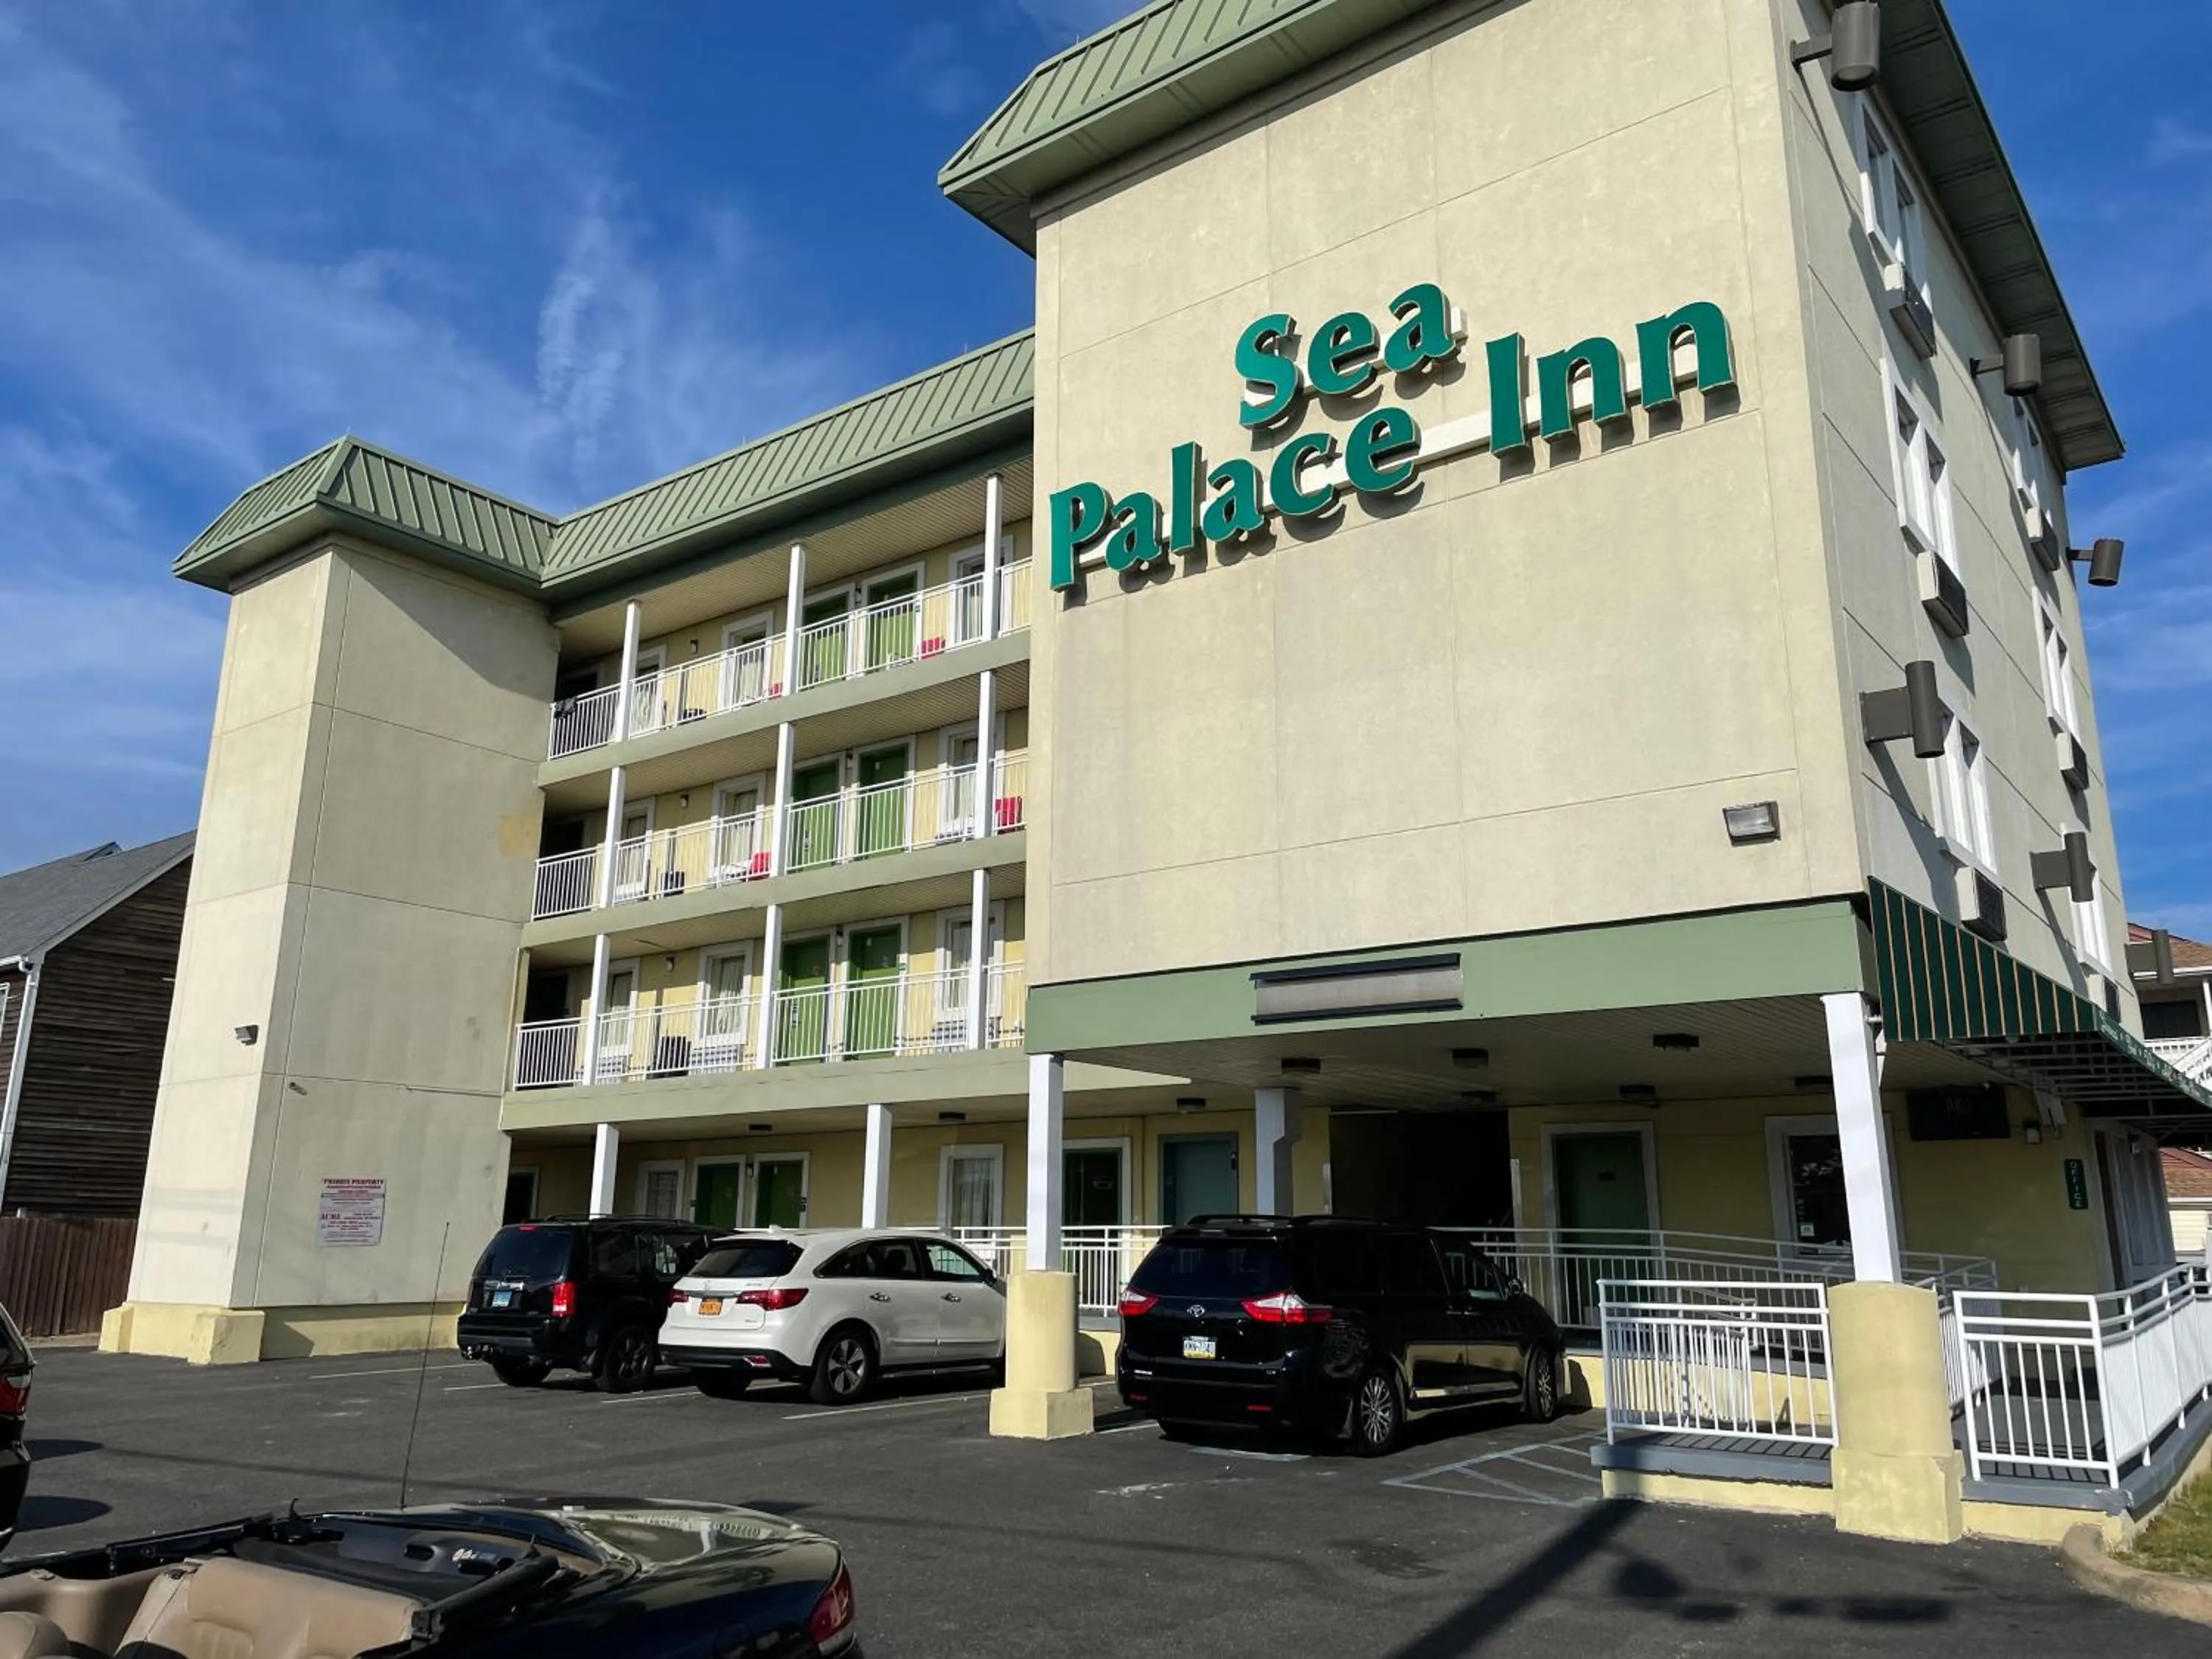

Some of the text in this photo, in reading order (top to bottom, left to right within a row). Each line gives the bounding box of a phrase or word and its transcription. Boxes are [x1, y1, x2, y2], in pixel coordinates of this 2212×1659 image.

[1049, 300, 1738, 591] Palace Inn
[1234, 282, 1457, 428] Sea
